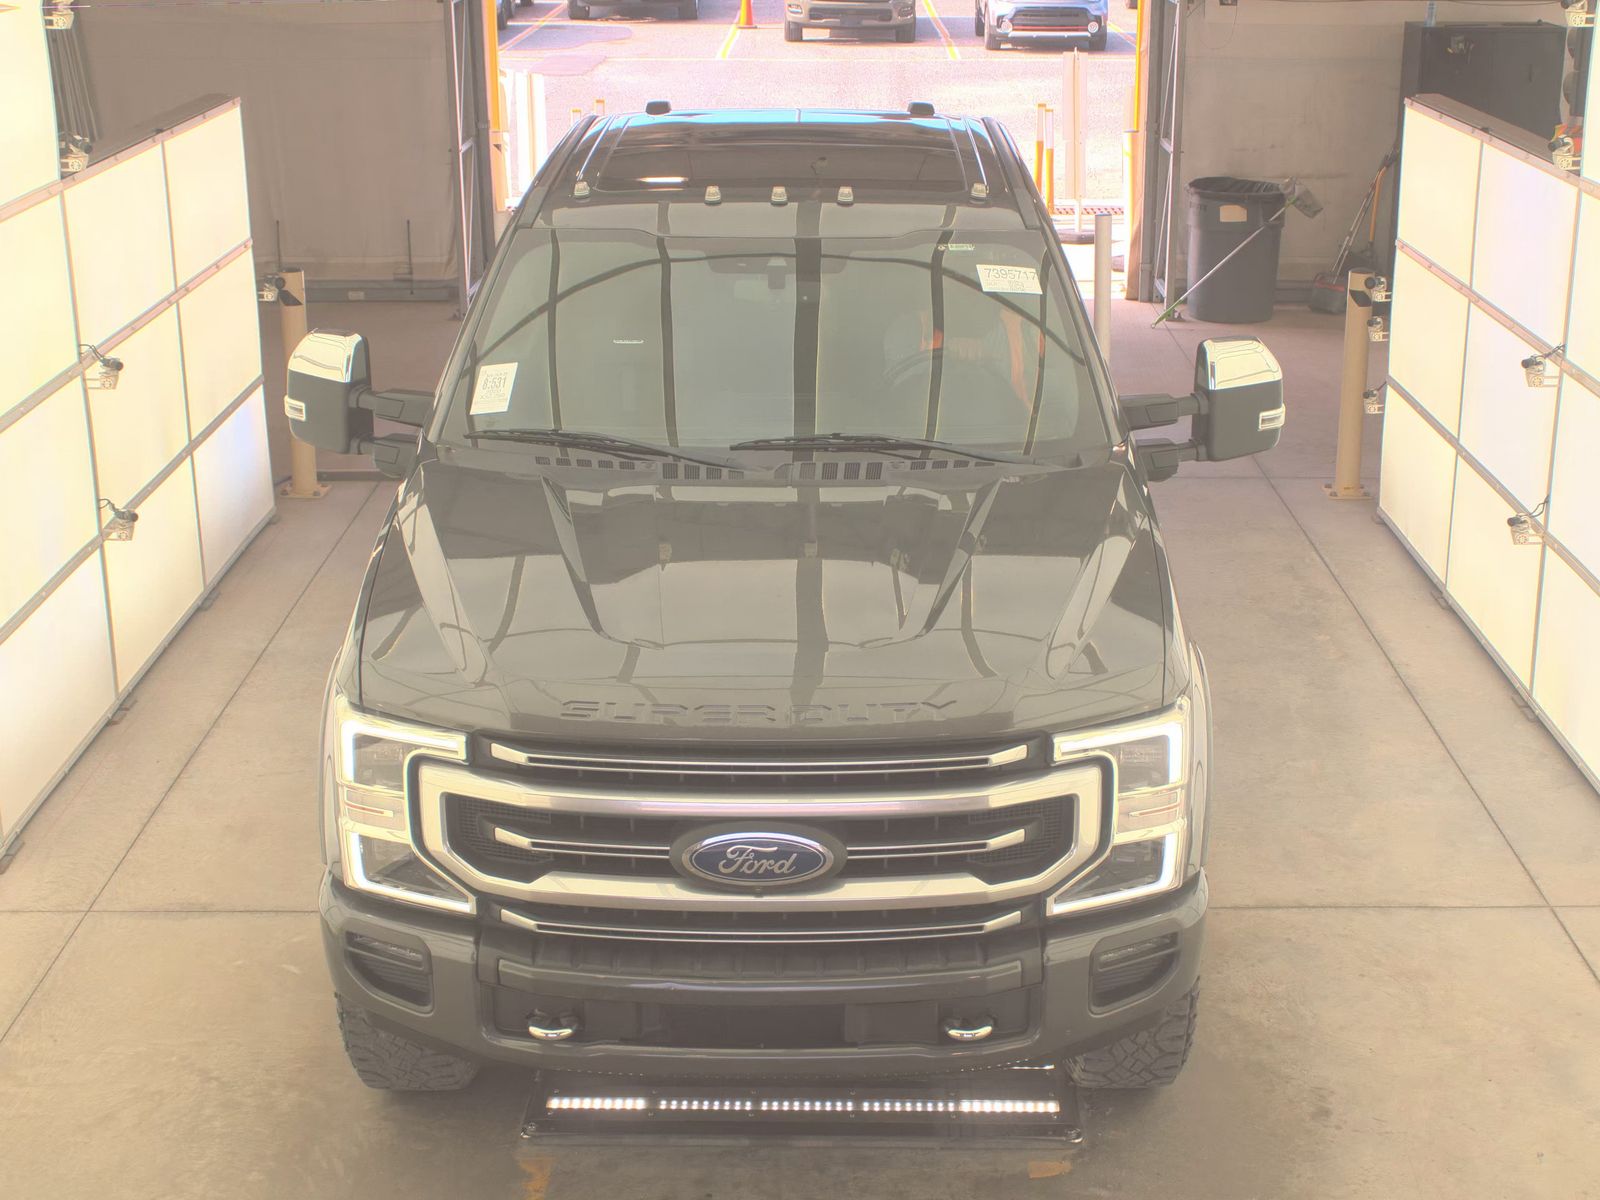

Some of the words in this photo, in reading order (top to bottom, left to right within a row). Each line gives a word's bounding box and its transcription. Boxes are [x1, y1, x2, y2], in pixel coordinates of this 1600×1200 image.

[983, 268, 1036, 281] 7395717
[560, 700, 776, 724] SUPER
[791, 700, 957, 724] DUTY
[718, 845, 797, 874] Ford
